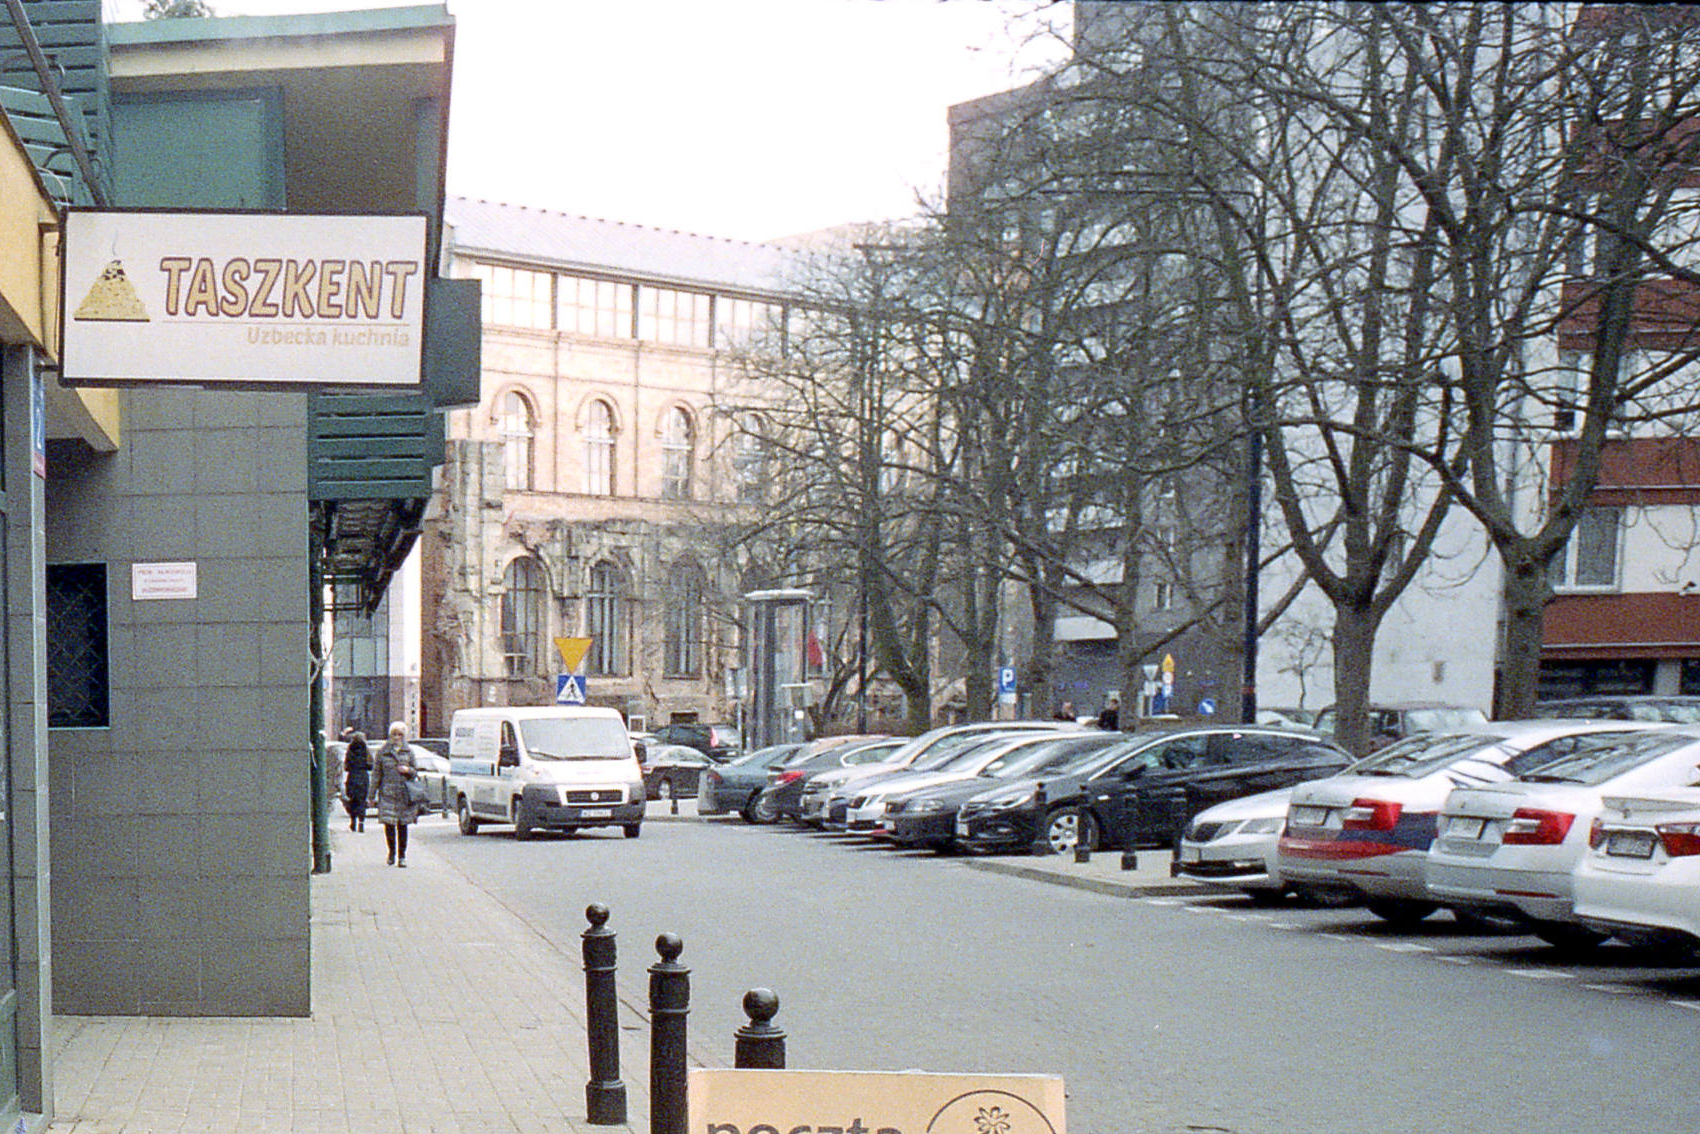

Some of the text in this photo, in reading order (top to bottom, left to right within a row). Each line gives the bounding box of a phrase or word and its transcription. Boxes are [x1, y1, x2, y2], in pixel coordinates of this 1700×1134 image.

[160, 257, 417, 319] TASZKENT
[247, 326, 409, 346] Uzbecka kuchnia
[1002, 669, 1013, 687] P
